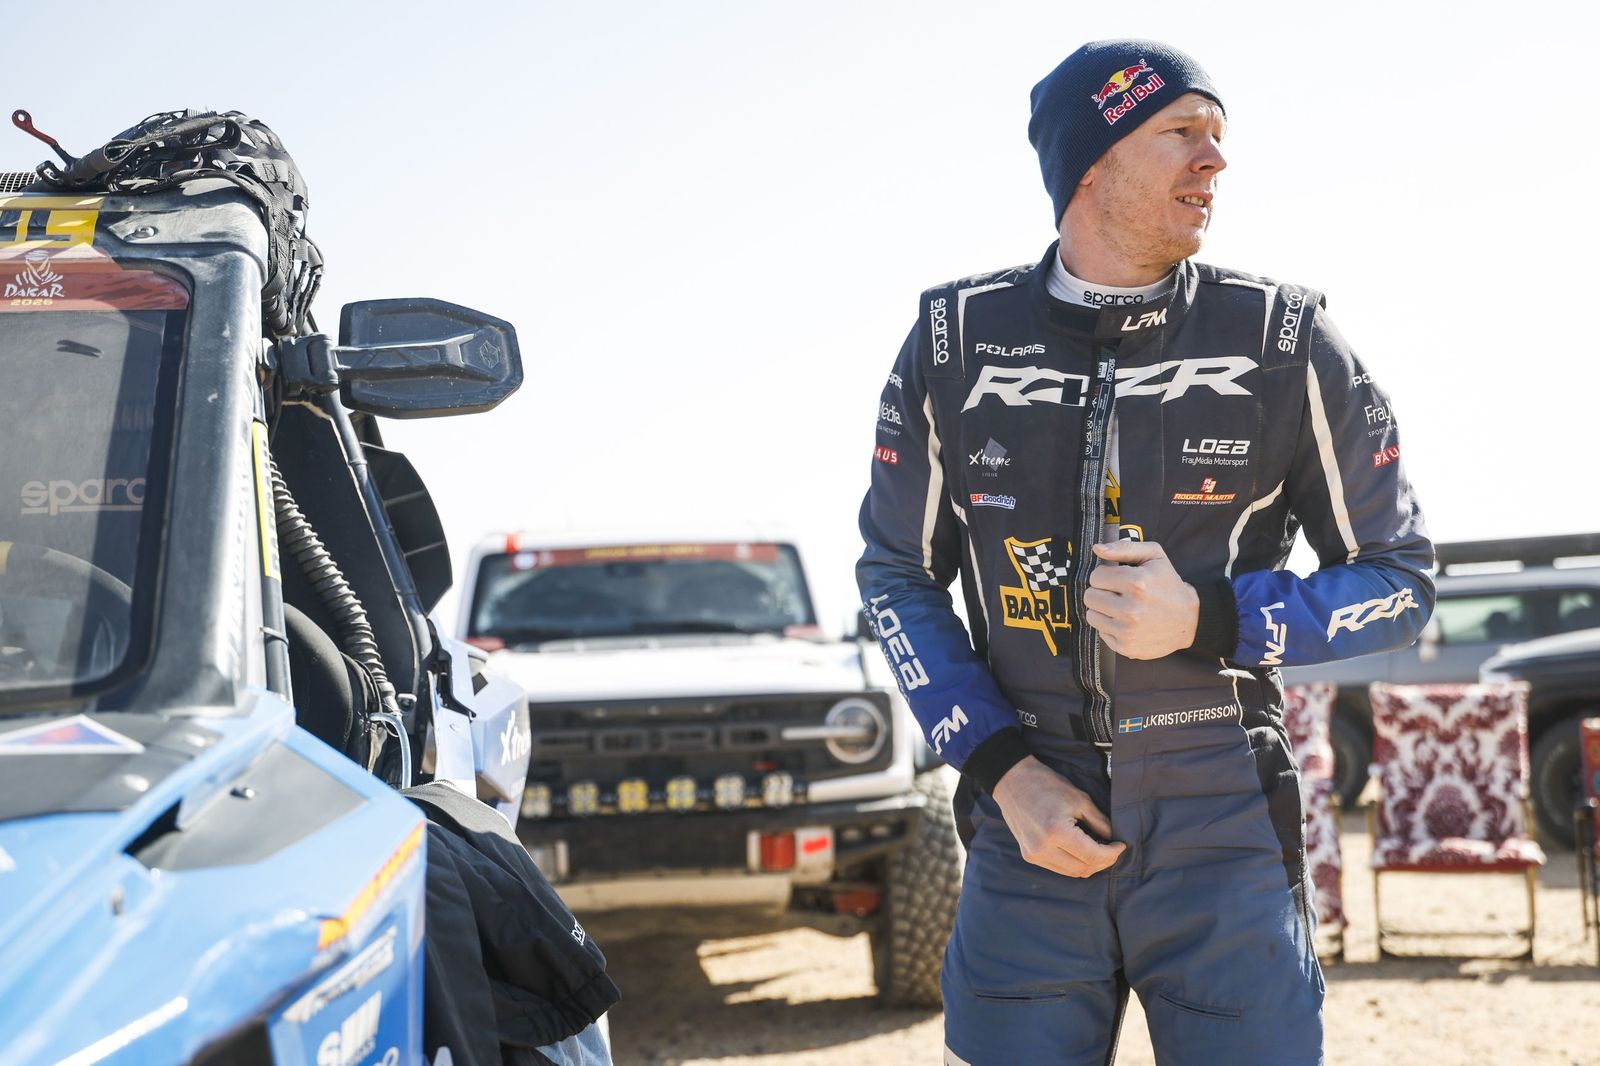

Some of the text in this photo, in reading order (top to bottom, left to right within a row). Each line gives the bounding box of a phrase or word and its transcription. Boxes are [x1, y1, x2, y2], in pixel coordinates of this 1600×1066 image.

[1103, 73, 1165, 125] Red Bull
[4, 283, 65, 298] DAKAR
[1083, 290, 1144, 306] sparco
[930, 298, 949, 366] sparco
[1121, 307, 1167, 331] LFM
[1278, 292, 1307, 354] sparco
[975, 343, 1046, 357] POLARIS
[1182, 439, 1250, 454] LOEB
[1214, 457, 1248, 468] Motorsport
[21, 477, 146, 516] sparc
[970, 493, 1015, 506] BFGoodrich
[1326, 587, 1420, 643] RZR
[870, 593, 930, 691] LOEB
[1257, 601, 1288, 665] LFM
[1143, 703, 1238, 729] J.KRISTOFFERSSON
